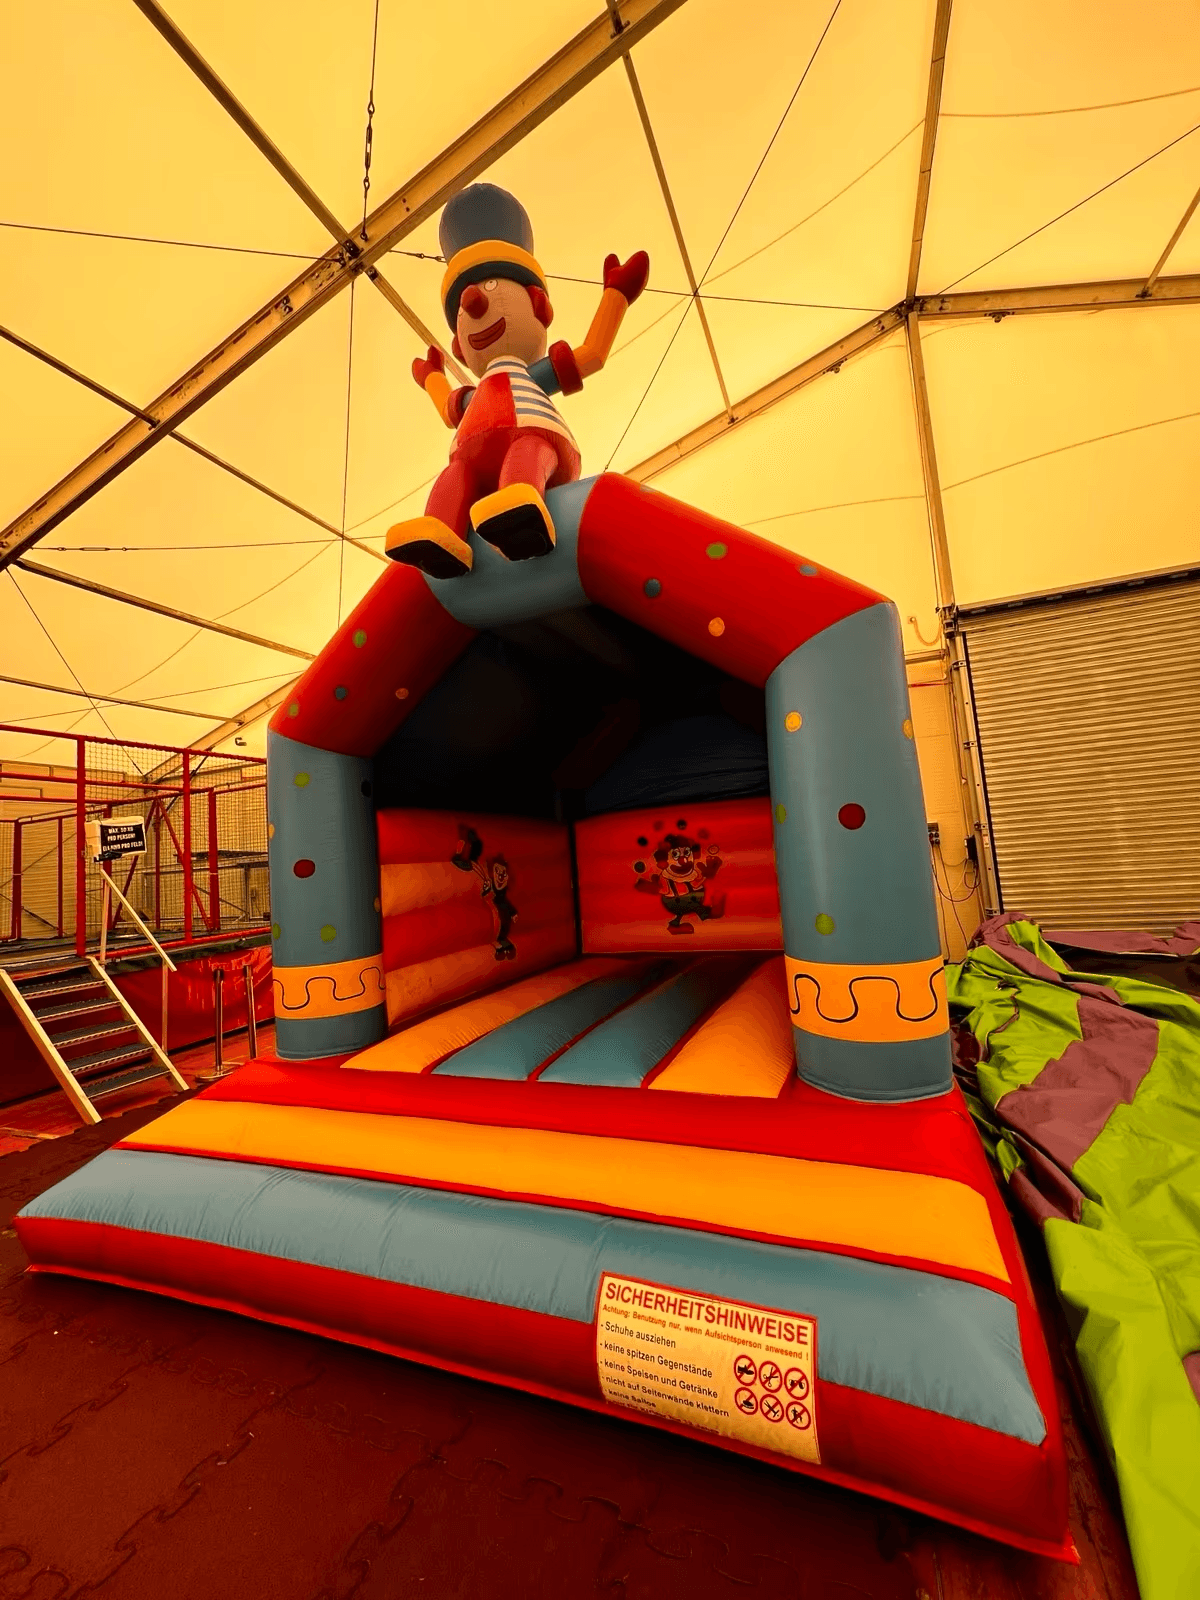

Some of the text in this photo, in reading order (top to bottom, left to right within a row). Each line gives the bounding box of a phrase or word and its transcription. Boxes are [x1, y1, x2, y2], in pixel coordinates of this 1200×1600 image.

[602, 1304, 630, 1318] Achtung:
[632, 1312, 666, 1328] Benutzung
[684, 1325, 702, 1335] wenn
[704, 1329, 762, 1350] Aufsichtsperson
[765, 1344, 802, 1360] anwesend
[606, 1282, 808, 1345] SICHERHEITSHINWEISE
[605, 1321, 676, 1348] Schuhe ausziehen
[604, 1340, 713, 1378] keine spitzen Gegenstände
[604, 1358, 718, 1399] keine Speisen und Getränke
[606, 1376, 626, 1388] nicht
[628, 1383, 640, 1392] auf
[642, 1386, 694, 1408] Seitenwände
[696, 1401, 730, 1418] klettern
